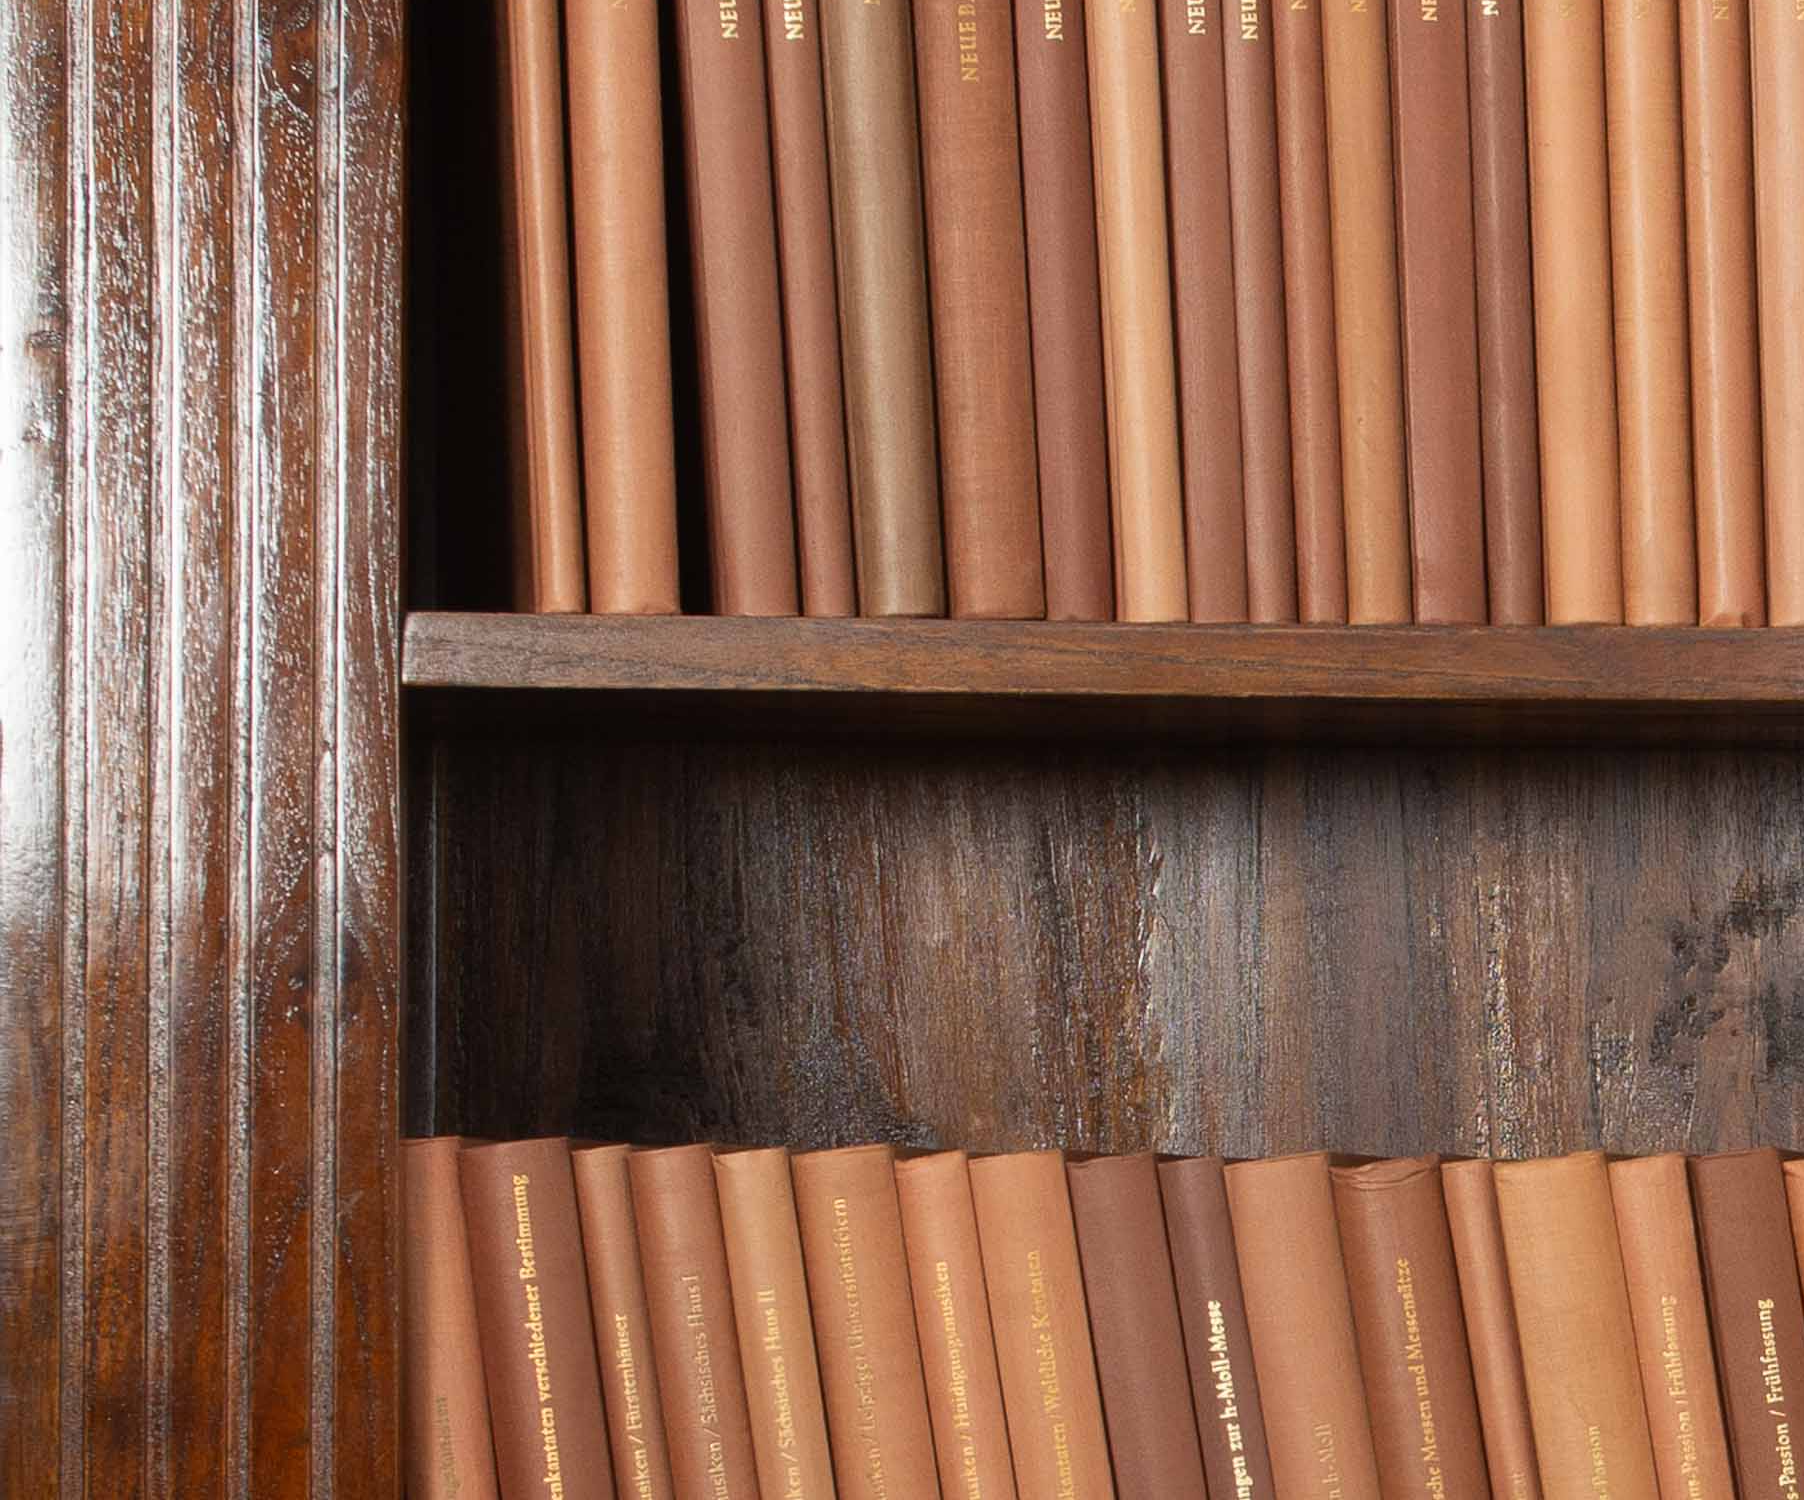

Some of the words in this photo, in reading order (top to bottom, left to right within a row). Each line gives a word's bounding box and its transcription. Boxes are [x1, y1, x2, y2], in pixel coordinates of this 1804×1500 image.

[512, 1173, 536, 1280] Bestimmung
[523, 1283, 552, 1402] verschiedener
[1207, 1299, 1238, 1419] h-Moll-Messe
[1757, 1297, 1784, 1403] Frühfassung
[1225, 1421, 1243, 1451] zur
